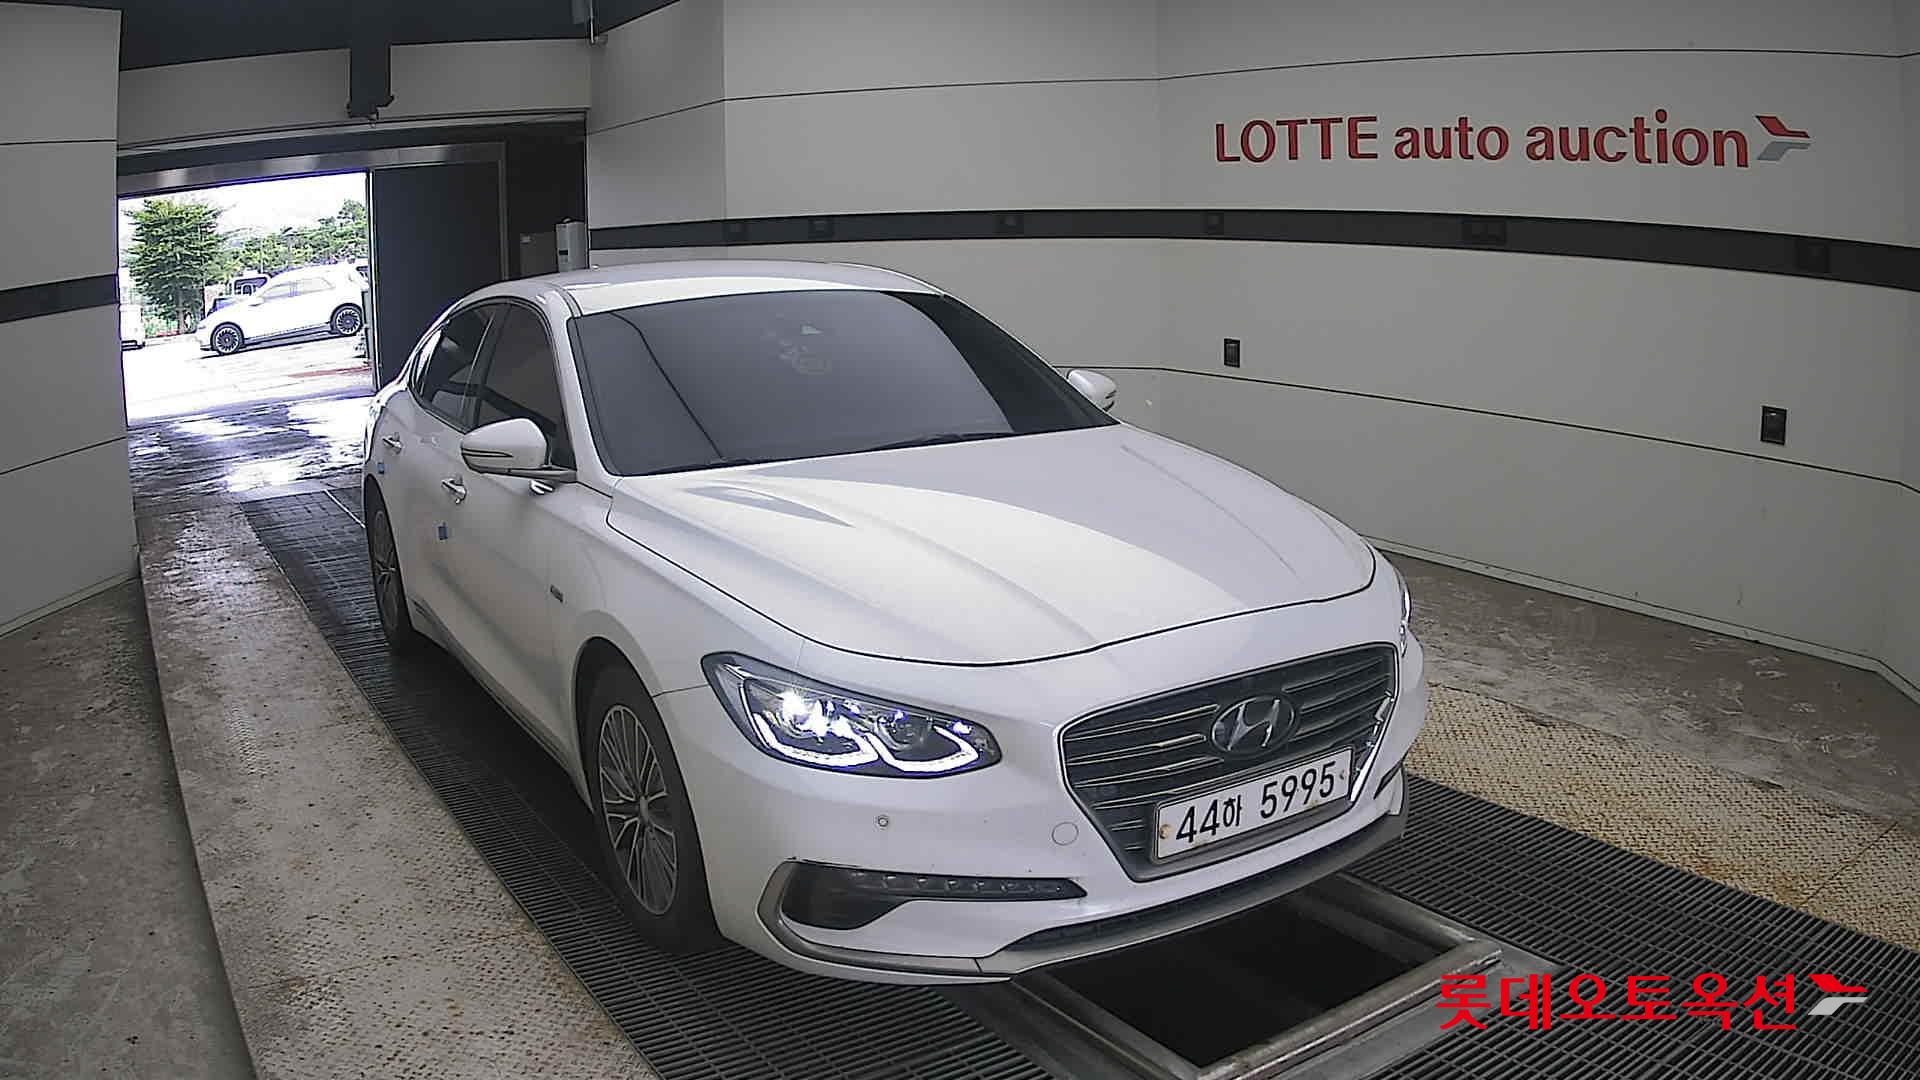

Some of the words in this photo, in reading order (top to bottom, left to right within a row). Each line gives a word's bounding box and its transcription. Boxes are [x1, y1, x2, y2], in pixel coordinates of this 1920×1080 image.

[1215, 115, 1378, 163] LOTTE
[1393, 116, 1510, 161] auto
[1525, 109, 1750, 168] auction
[1176, 794, 1242, 843] 44하
[1260, 761, 1336, 819] 5995
